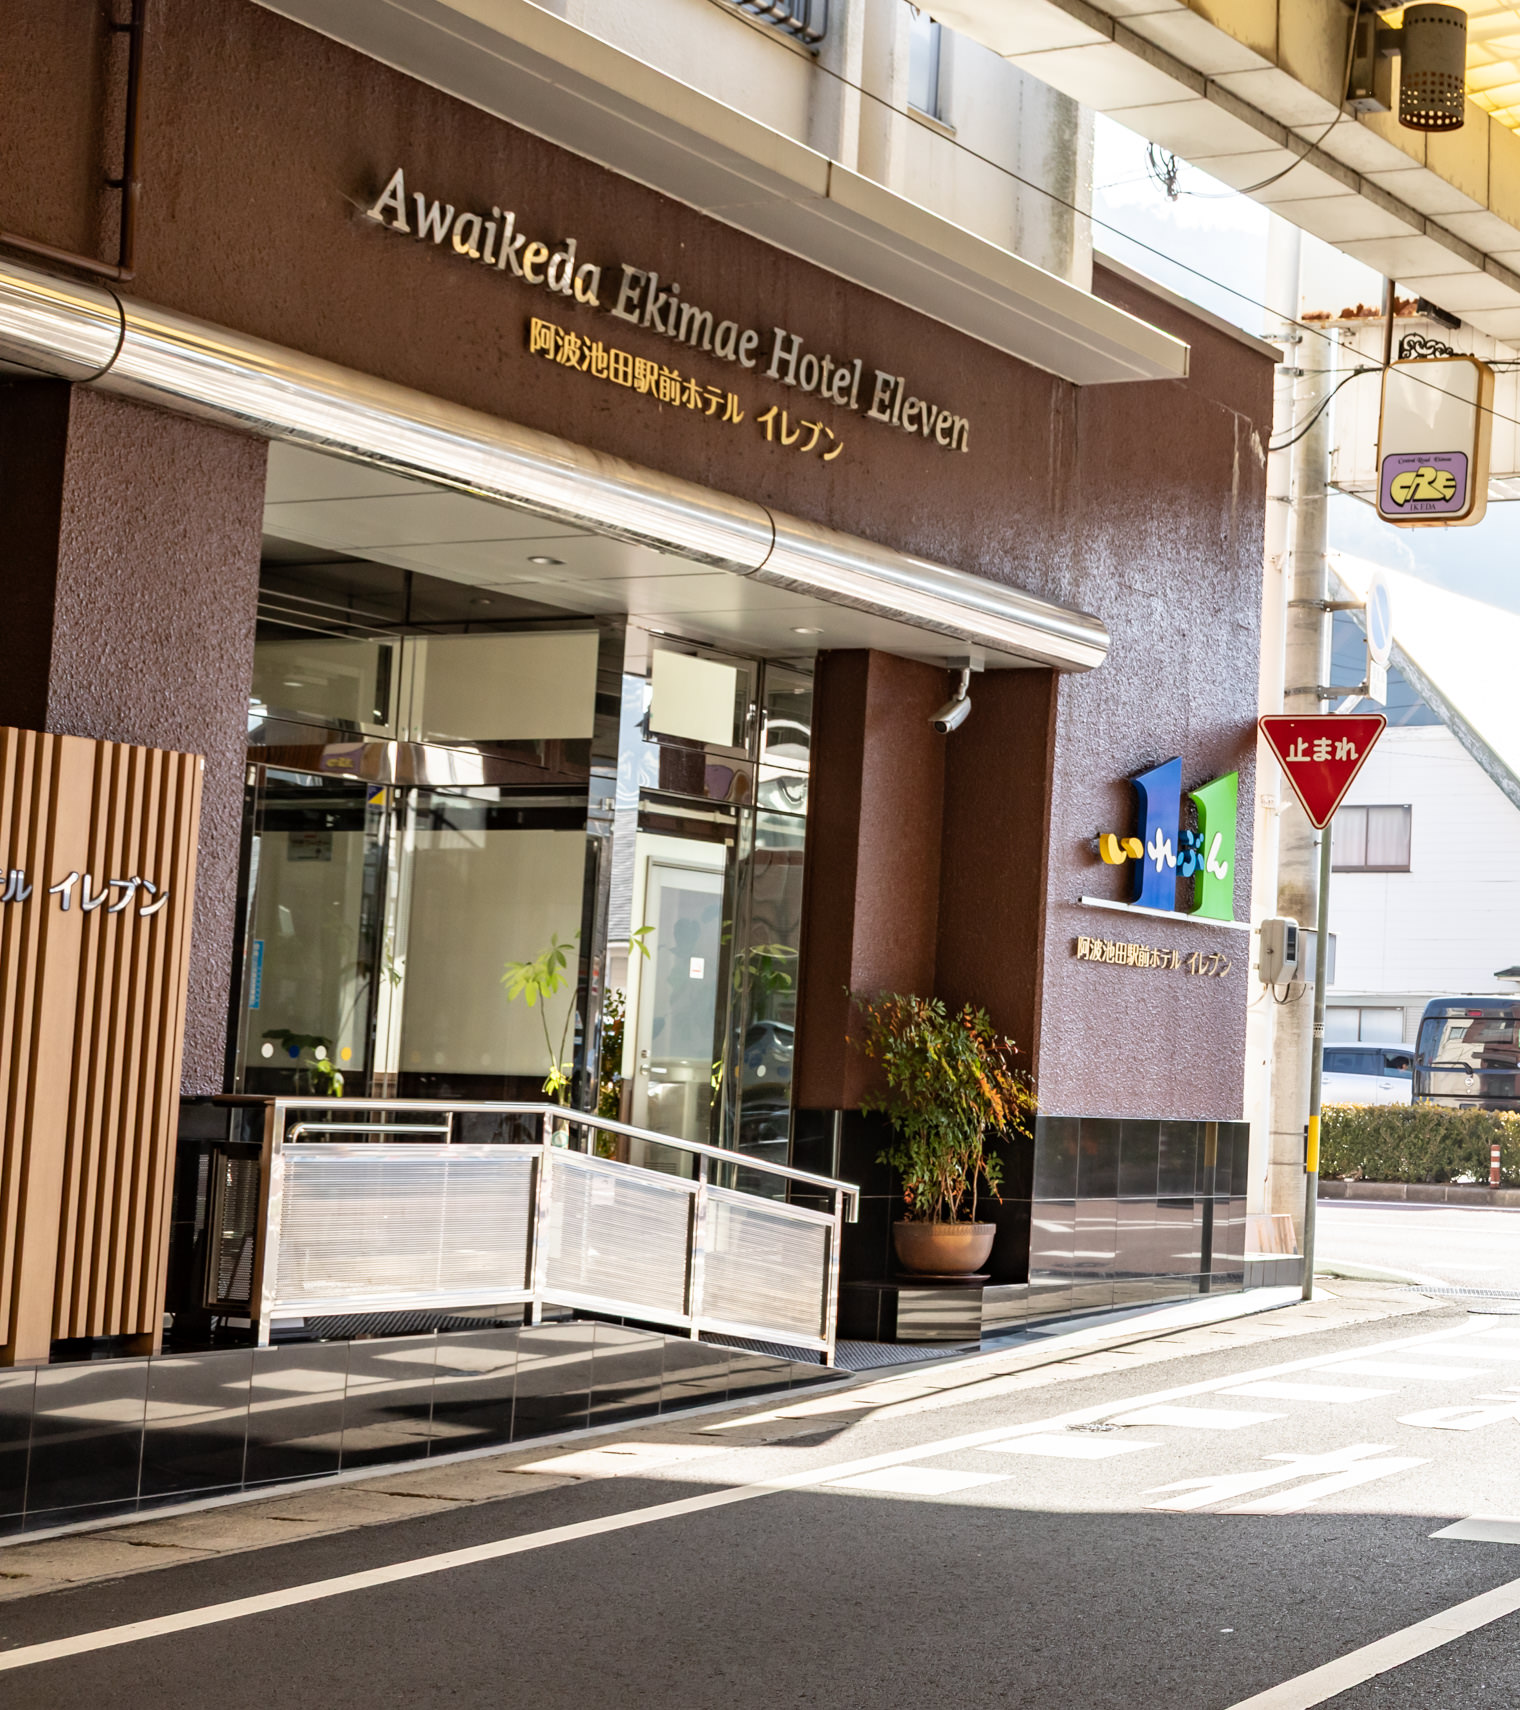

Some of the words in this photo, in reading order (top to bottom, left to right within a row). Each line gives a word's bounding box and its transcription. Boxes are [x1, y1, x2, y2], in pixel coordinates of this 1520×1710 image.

[366, 167, 600, 308] Awaikeda
[611, 263, 759, 369] Ekimae
[767, 327, 861, 411] Hotel
[869, 370, 970, 452] Eleven
[529, 316, 744, 424] 阿波池田駅前ホテル
[757, 406, 843, 461] イレブン
[1285, 736, 1359, 762] 止まれ
[1100, 828, 1229, 880] いれぶん
[0, 868, 32, 902] ル
[49, 871, 169, 916] イレブン
[1077, 936, 1181, 970] 阿波池田駅前ホテル
[1187, 951, 1232, 977] イレブン
